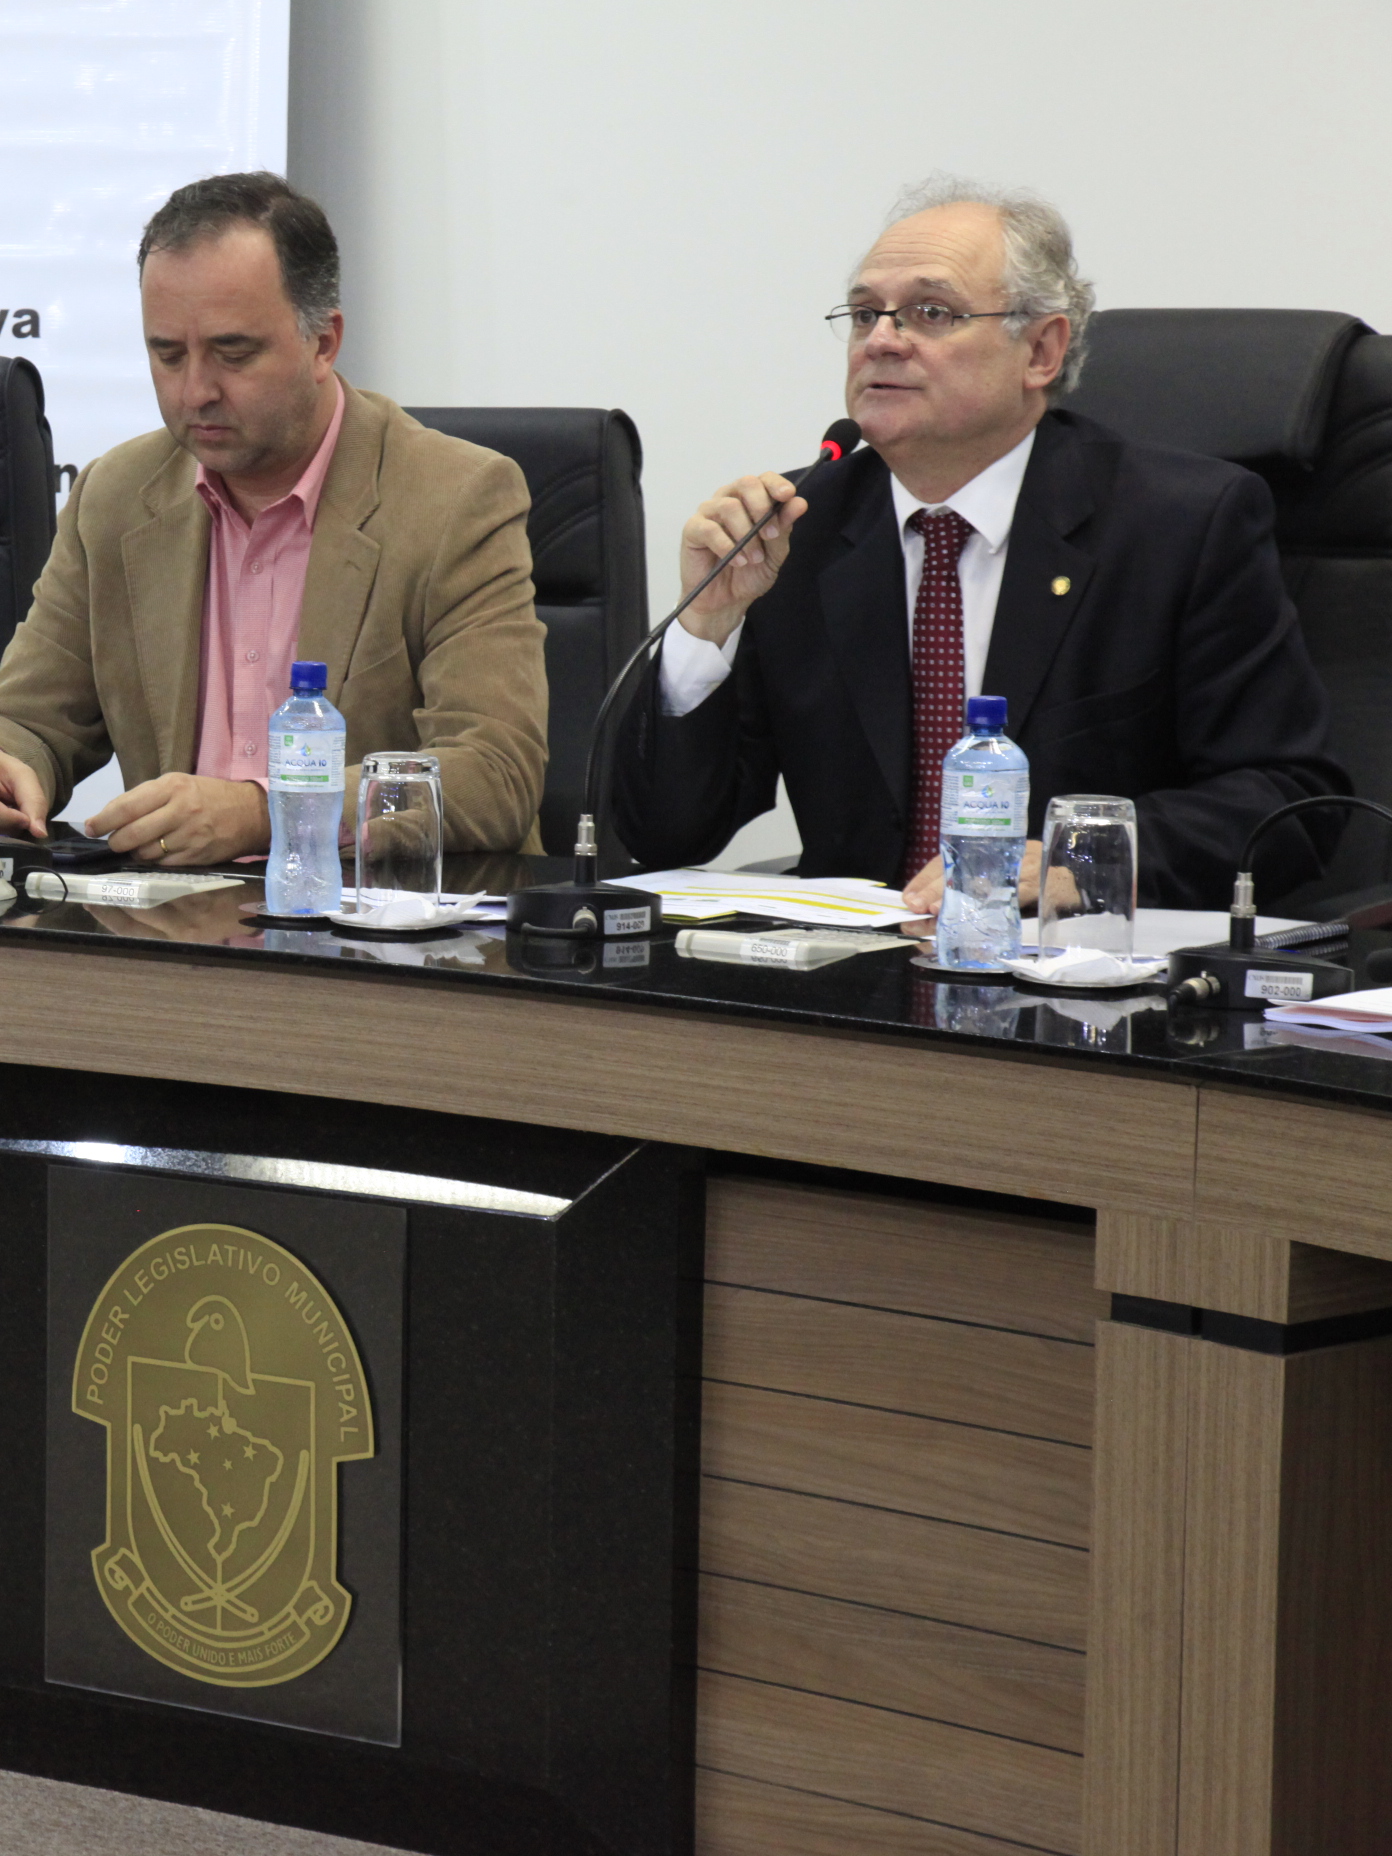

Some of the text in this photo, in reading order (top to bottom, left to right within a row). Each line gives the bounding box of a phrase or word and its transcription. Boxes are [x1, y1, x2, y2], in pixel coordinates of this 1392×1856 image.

[285, 759, 316, 767] ACQUA
[963, 801, 999, 809] ACQUA
[101, 884, 135, 897] 97-000
[751, 943, 788, 957] 650-000
[1261, 984, 1302, 997] 902-000
[86, 1243, 359, 1443] PODER LEGISLATIVO MUNICIPAL
[147, 1612, 157, 1625] O
[156, 1620, 191, 1652] PODER
[192, 1643, 226, 1666] UNIDO
[237, 1648, 263, 1665] MAIS
[264, 1631, 297, 1658] FORTE
